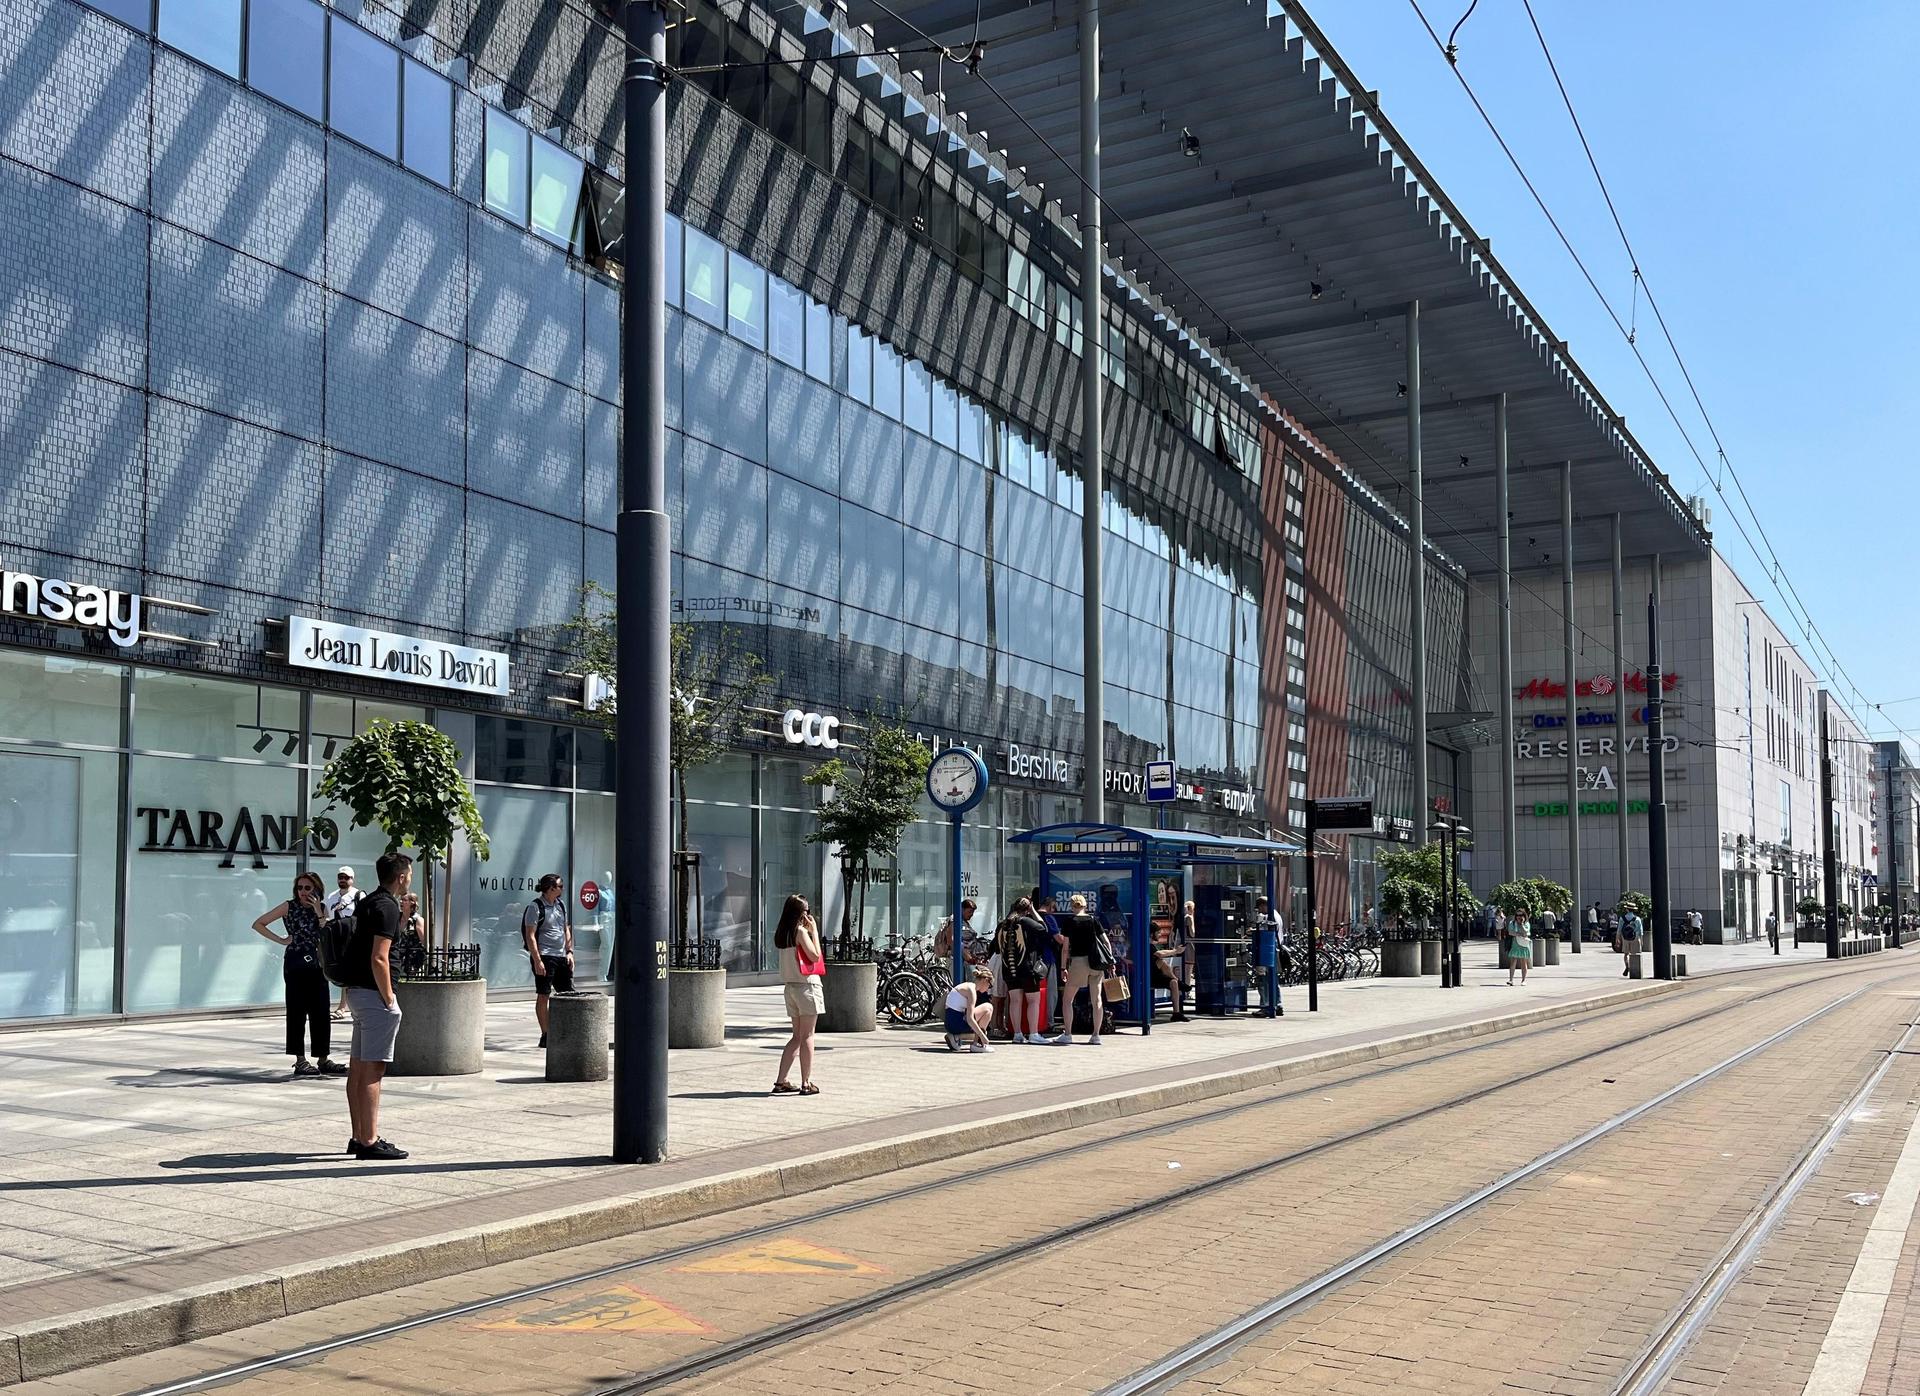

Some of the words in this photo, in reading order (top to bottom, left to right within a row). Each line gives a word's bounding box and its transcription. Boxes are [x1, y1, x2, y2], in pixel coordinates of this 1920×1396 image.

[0, 570, 140, 648] nsay
[304, 626, 363, 667] Jean
[369, 637, 432, 677] Louis
[439, 649, 498, 688] David
[783, 709, 840, 749] CCC
[1009, 743, 1069, 783] Bershka
[1105, 769, 1147, 794] PHORA
[1223, 783, 1256, 817] empik
[479, 876, 541, 891] WÓLCZA
[961, 885, 979, 897] YLES
[655, 940, 667, 953] PA
[657, 953, 667, 965] 01
[656, 967, 667, 980] 20
